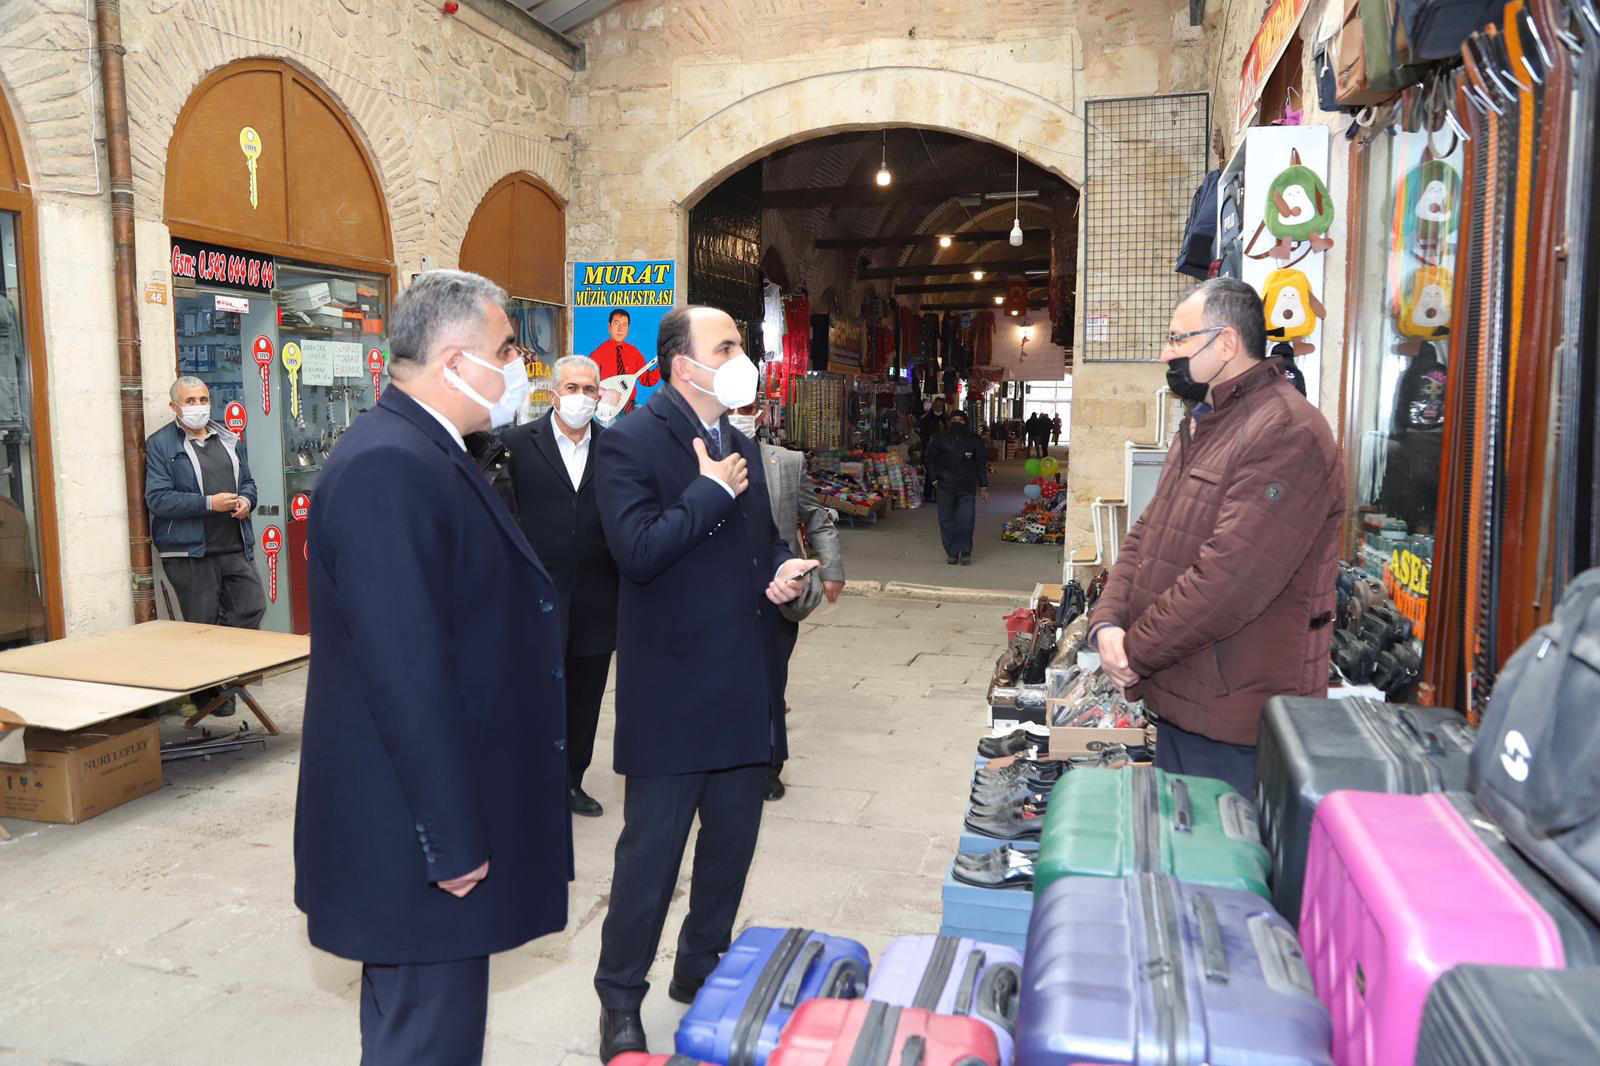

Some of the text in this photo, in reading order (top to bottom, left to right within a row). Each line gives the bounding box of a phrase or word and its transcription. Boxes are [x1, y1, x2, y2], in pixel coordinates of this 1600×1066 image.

[172, 245, 273, 289] Gsm: 0.542 644 05 44
[583, 264, 670, 285] MURAT
[151, 292, 162, 303] 46
[576, 287, 674, 306] MÜZİK ORKESTRASI
